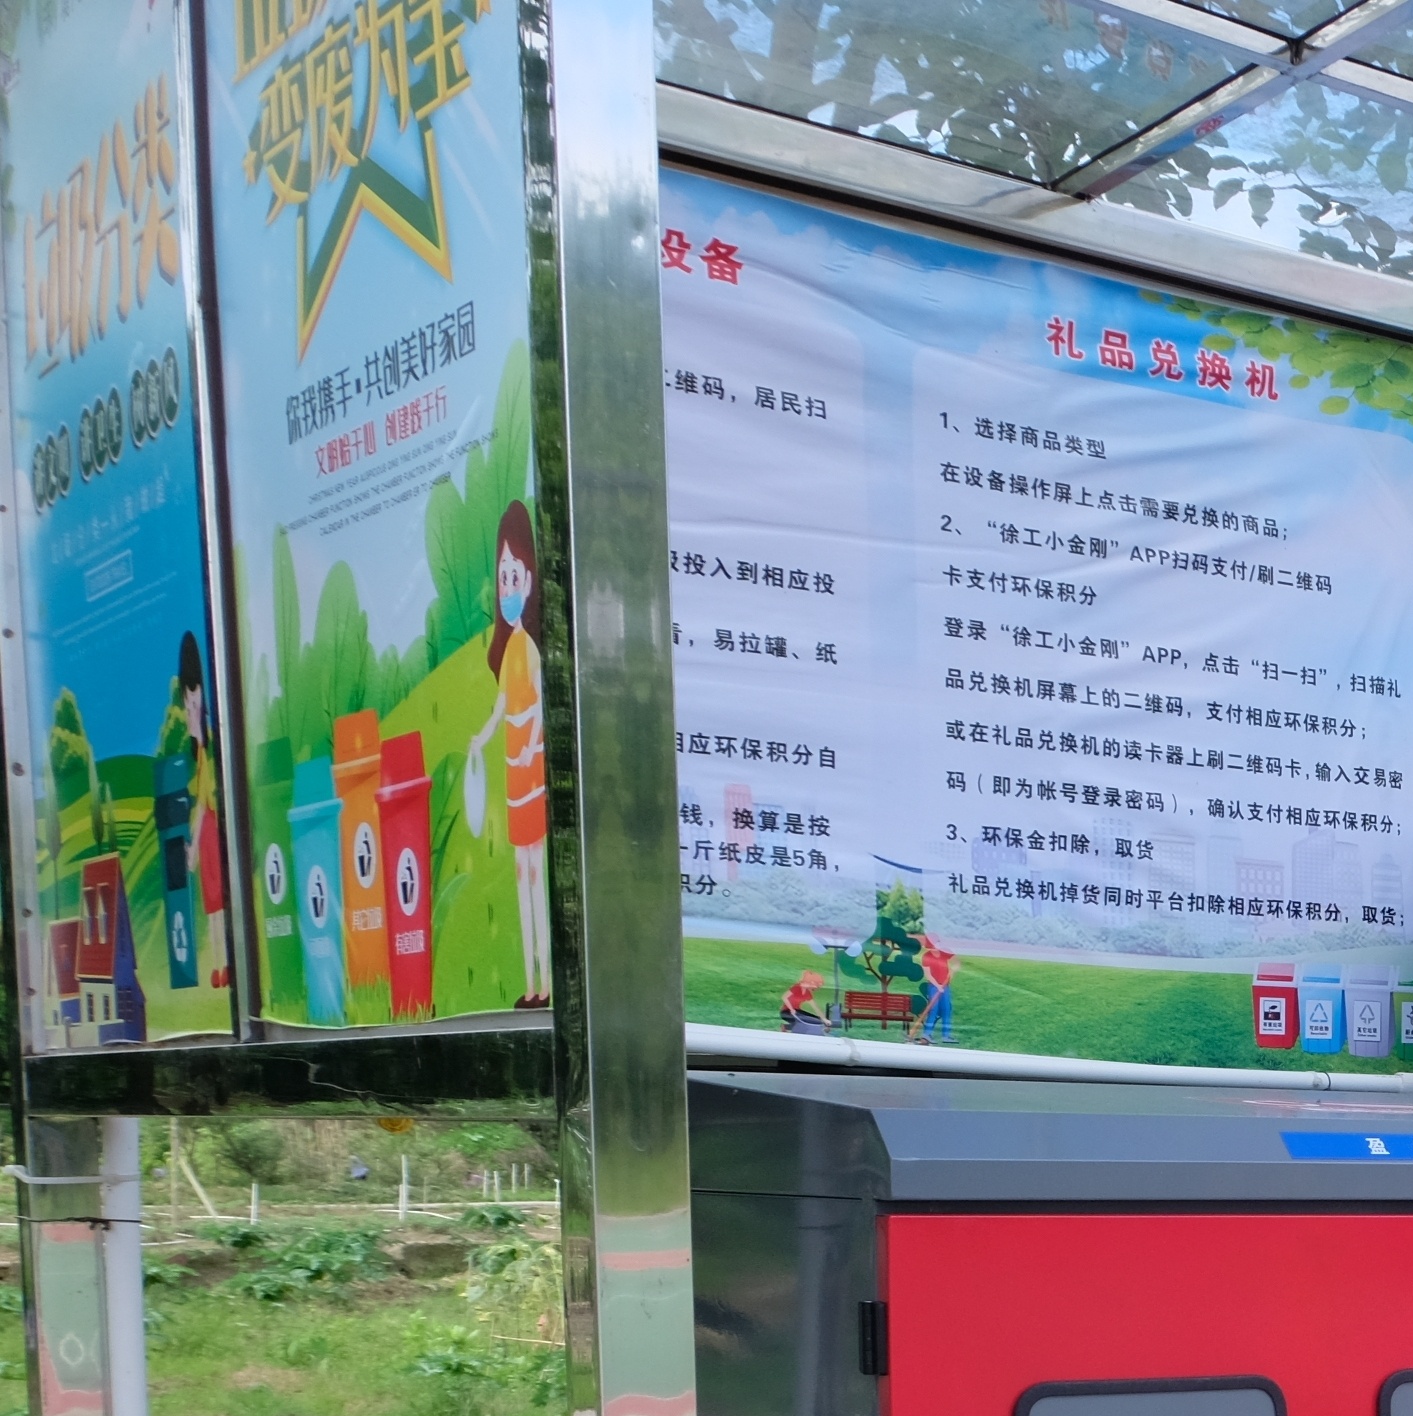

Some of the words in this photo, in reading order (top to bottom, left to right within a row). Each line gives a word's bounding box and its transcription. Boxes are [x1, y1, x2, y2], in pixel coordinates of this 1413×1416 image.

[1046, 316, 1280, 401] 礼品兑换机
[665, 369, 828, 420] 维码，居民扫
[939, 411, 1107, 460] 1、选择商品类型
[942, 565, 1098, 606] 卡支付环保积分
